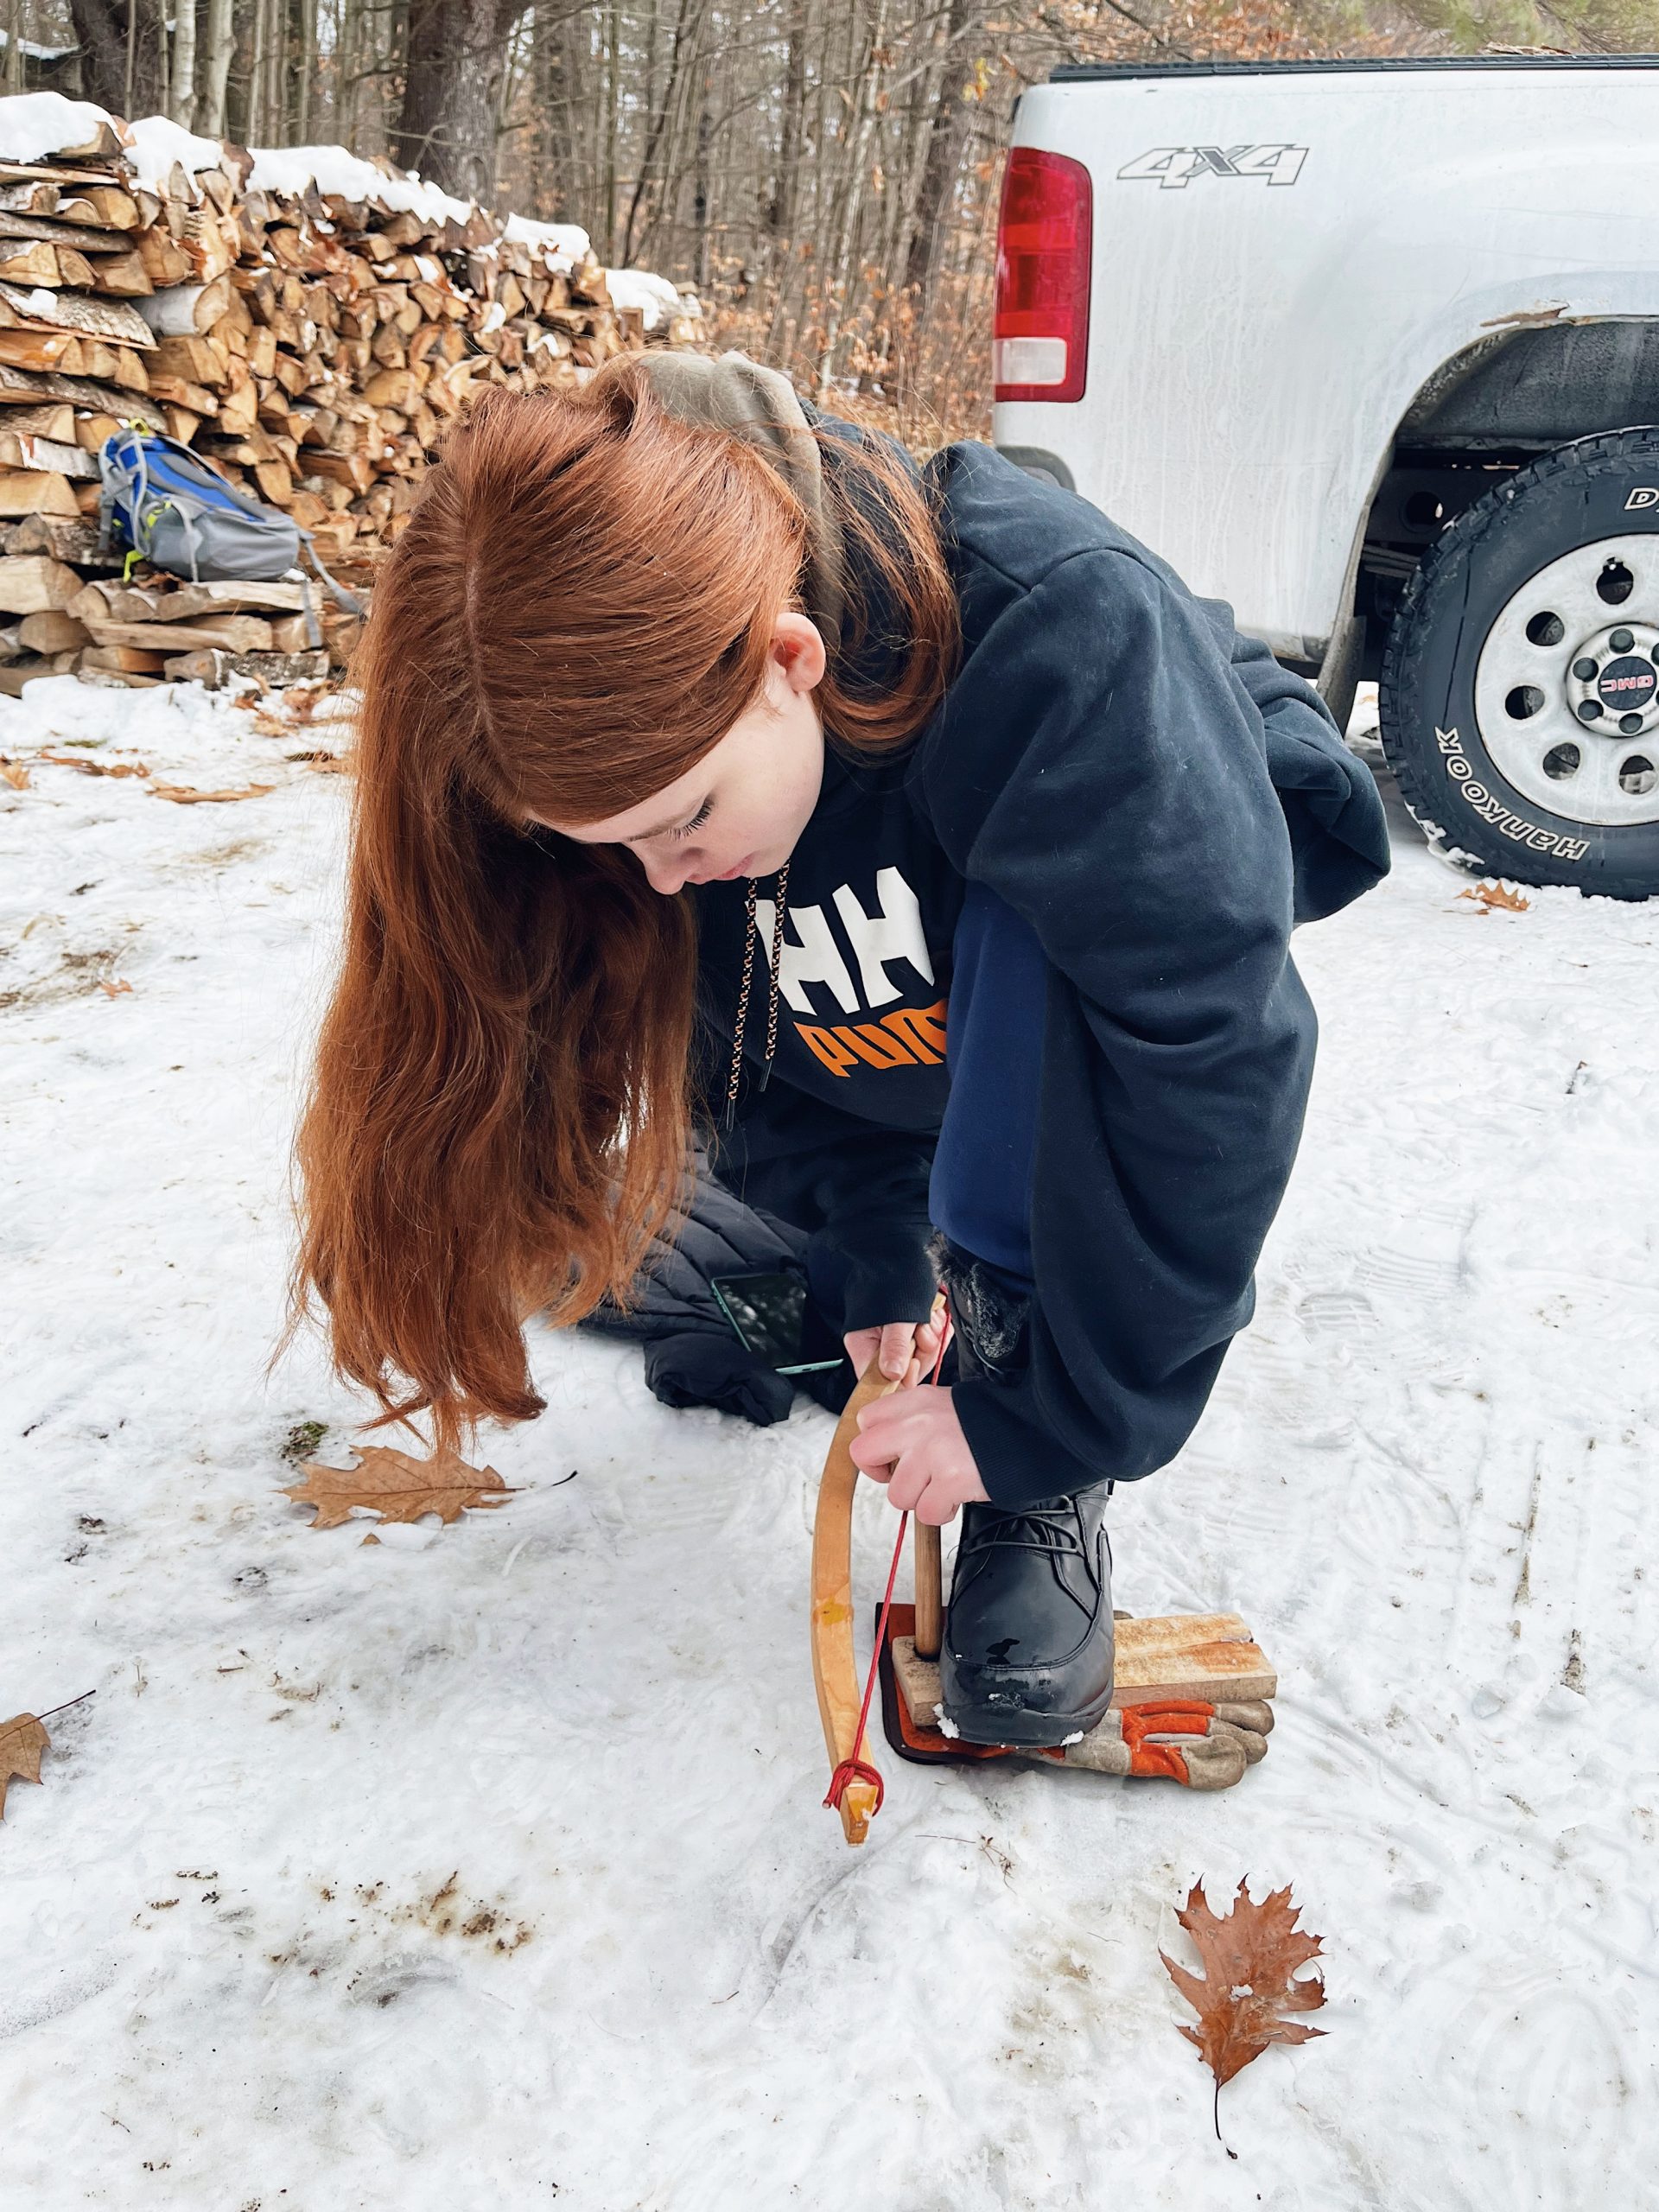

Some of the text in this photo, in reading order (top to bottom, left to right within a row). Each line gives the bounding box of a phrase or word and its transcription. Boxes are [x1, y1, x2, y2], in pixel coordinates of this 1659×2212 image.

[1116, 143, 1309, 188] 4X4
[1600, 675, 1654, 693] GMC
[744, 866, 935, 1016] HH
